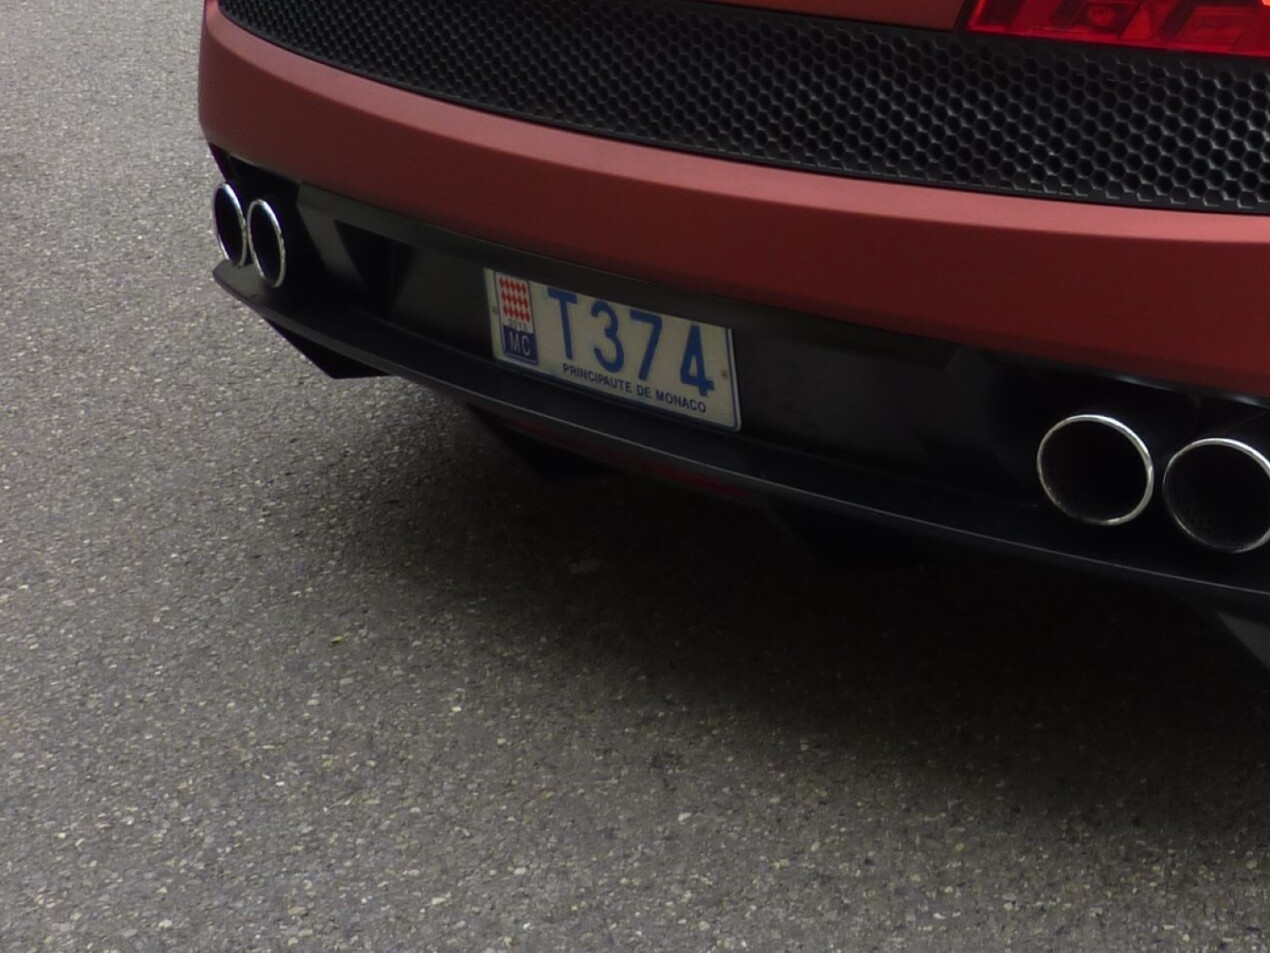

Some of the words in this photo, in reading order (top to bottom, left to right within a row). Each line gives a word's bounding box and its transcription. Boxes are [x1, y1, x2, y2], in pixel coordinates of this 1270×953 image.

[508, 330, 532, 357] MC
[546, 286, 715, 398] T374
[562, 362, 633, 393] PRINCIPAUTE
[636, 384, 652, 398] DE
[655, 389, 707, 414] MONACO
